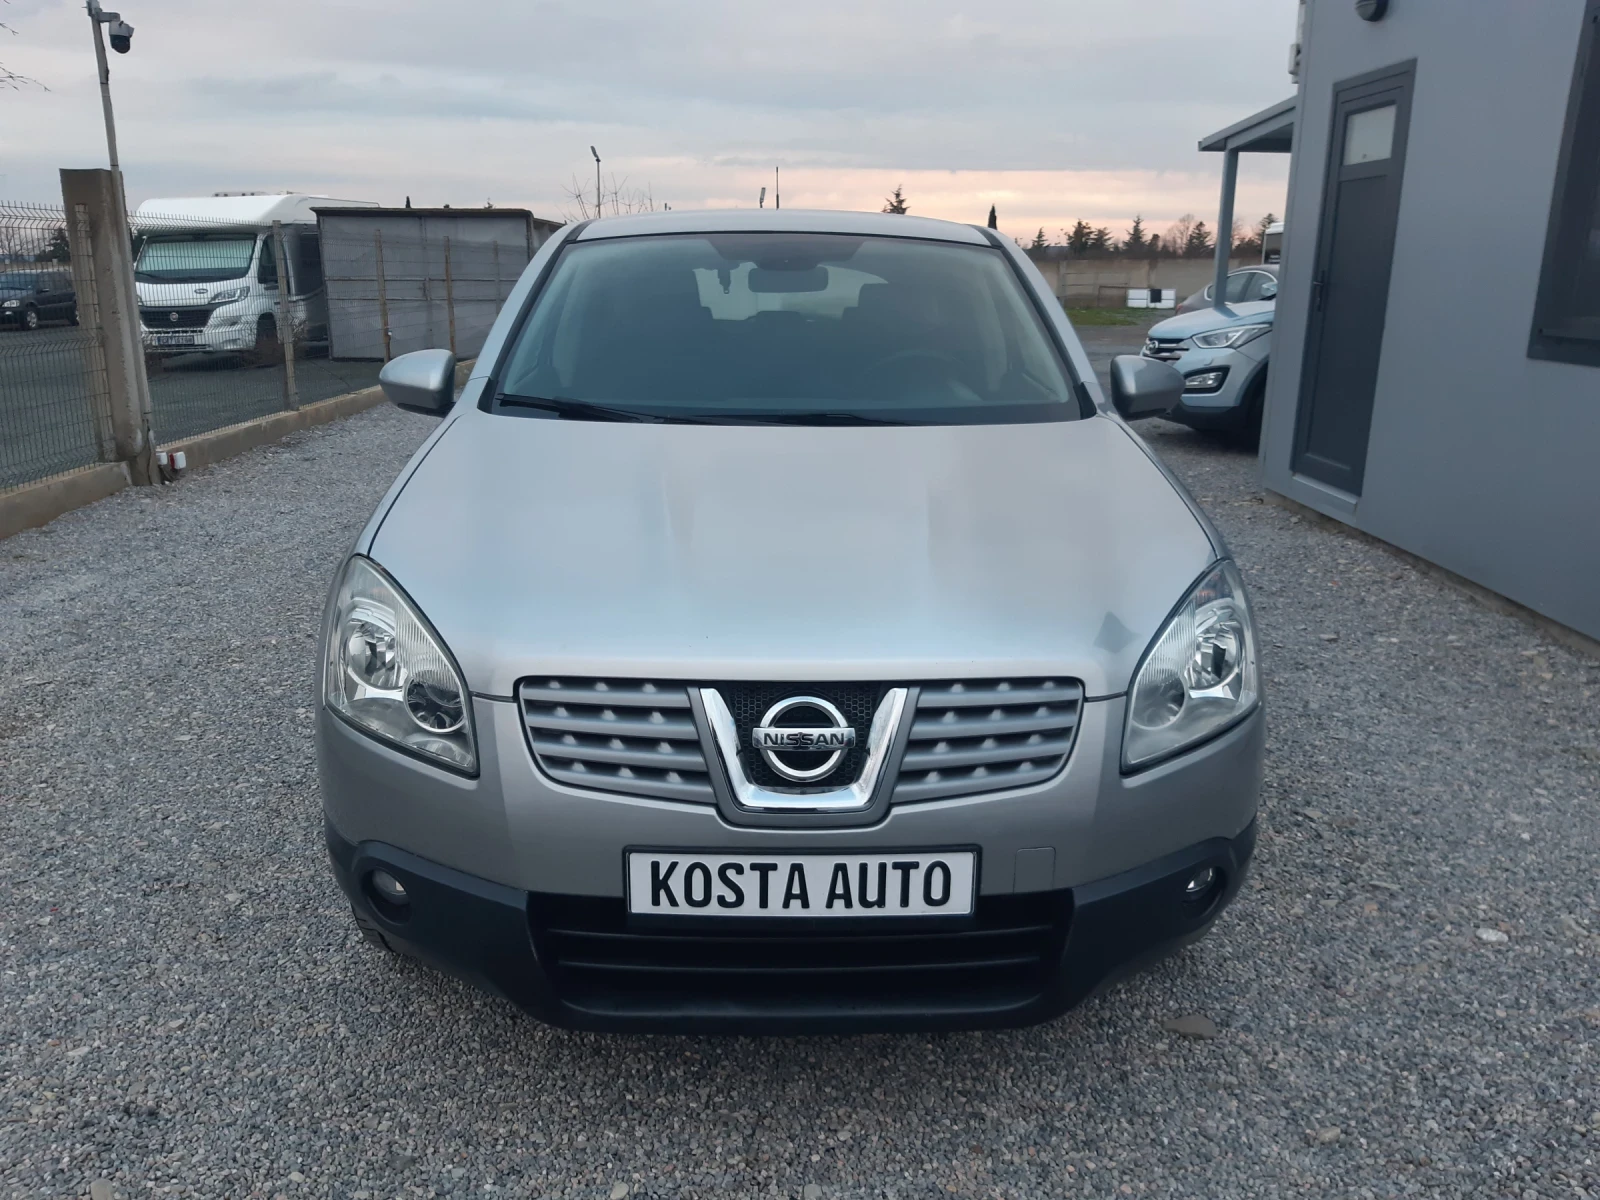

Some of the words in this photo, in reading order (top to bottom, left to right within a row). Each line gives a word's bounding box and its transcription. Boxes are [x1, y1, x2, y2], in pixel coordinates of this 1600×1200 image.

[763, 732, 845, 747] NISSAN
[650, 860, 810, 909] KOSTA
[825, 860, 952, 909] AUTO
